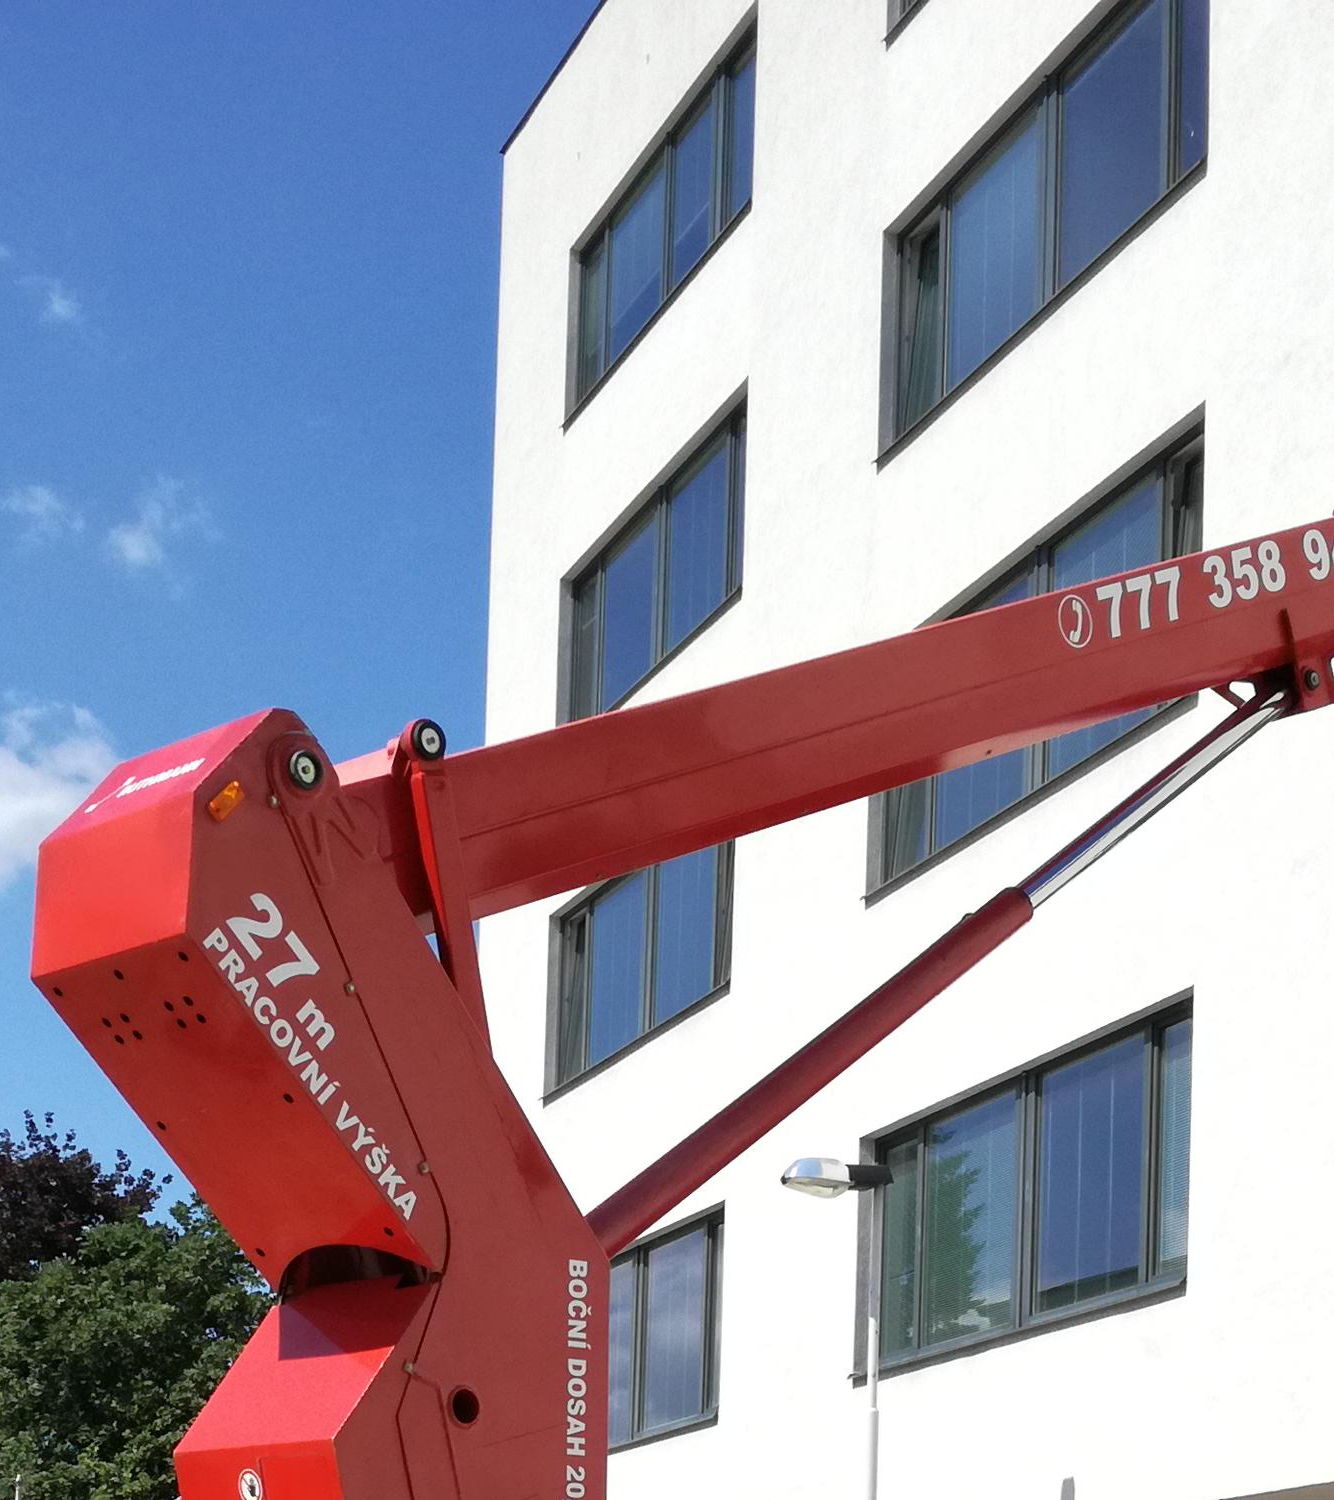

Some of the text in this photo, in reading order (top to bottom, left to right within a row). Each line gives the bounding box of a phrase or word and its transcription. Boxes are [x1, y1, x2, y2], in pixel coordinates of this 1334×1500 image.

[1095, 566, 1181, 638] 777
[1203, 540, 1286, 609] 358
[225, 892, 336, 1051] 27 m
[202, 928, 417, 1221] PRACOVNÍ VÝŠKA
[567, 1259, 592, 1350] BOČNÍ
[566, 1359, 587, 1456] DOSAH
